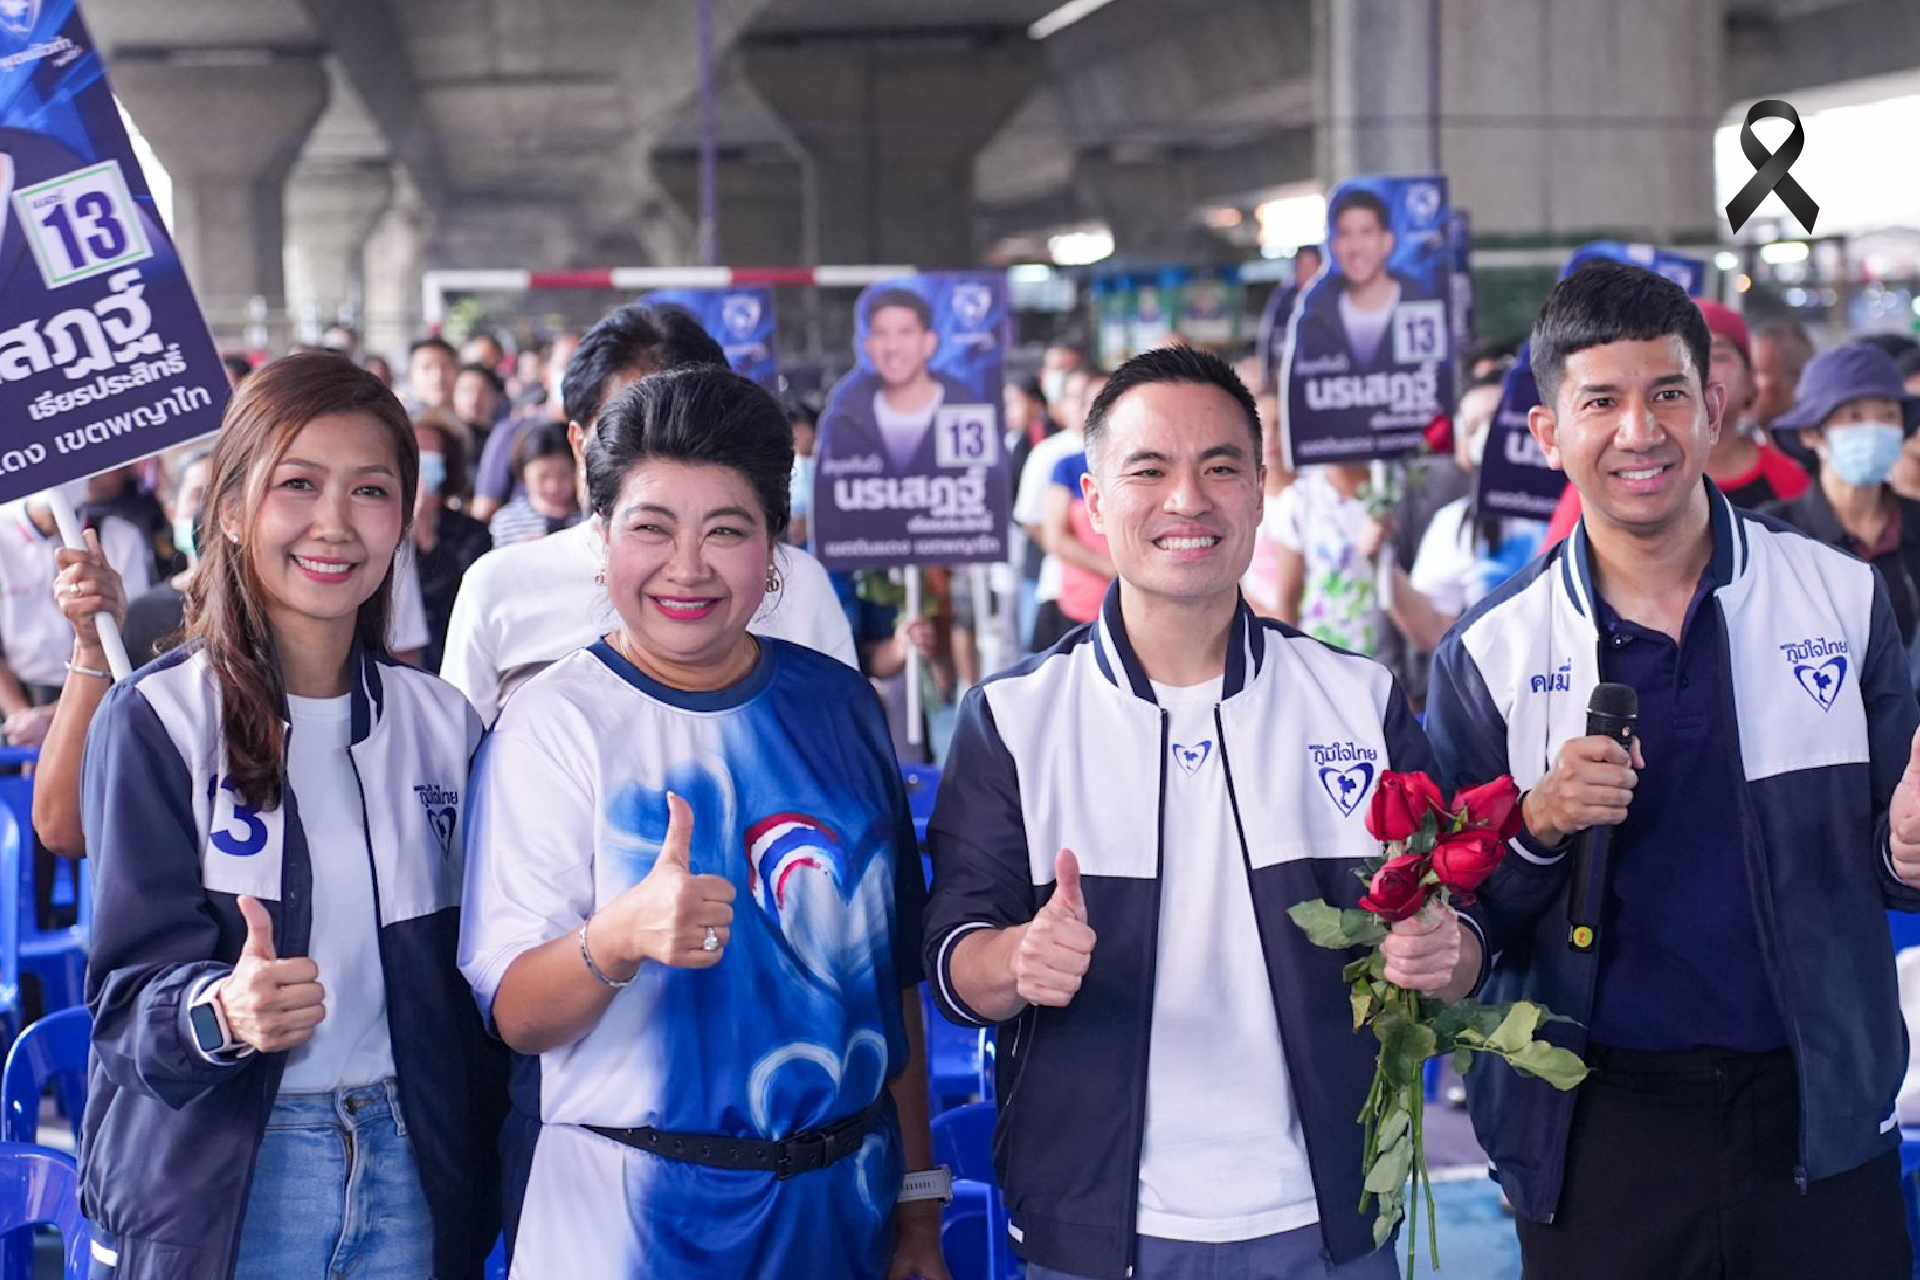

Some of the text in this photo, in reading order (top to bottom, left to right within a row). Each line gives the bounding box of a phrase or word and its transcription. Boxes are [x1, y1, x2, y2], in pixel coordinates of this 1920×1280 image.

[42, 190, 126, 269] 13
[0, 268, 164, 384] สฎฐ์
[1406, 318, 1437, 354] 13
[0, 385, 213, 475] ดง เขตพญาไท
[950, 421, 985, 459] 13
[1308, 742, 1379, 766] ภูมิใจไทย
[207, 773, 271, 858] 3
